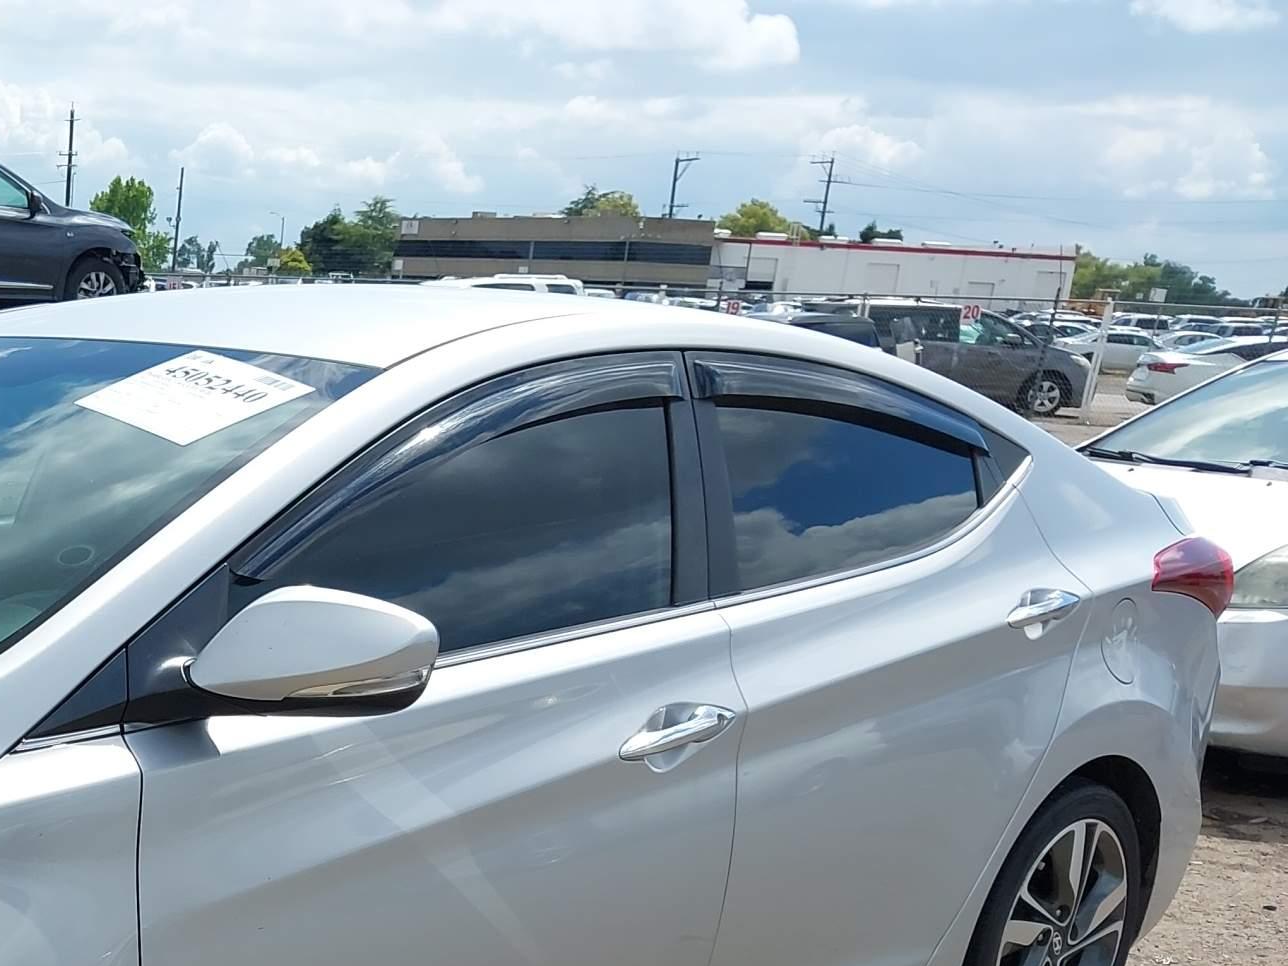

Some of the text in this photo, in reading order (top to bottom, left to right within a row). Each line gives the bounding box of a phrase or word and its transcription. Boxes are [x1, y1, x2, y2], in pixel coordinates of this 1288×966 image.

[727, 301, 740, 315] 19
[963, 304, 980, 320] 20
[165, 365, 269, 403] 45052440
